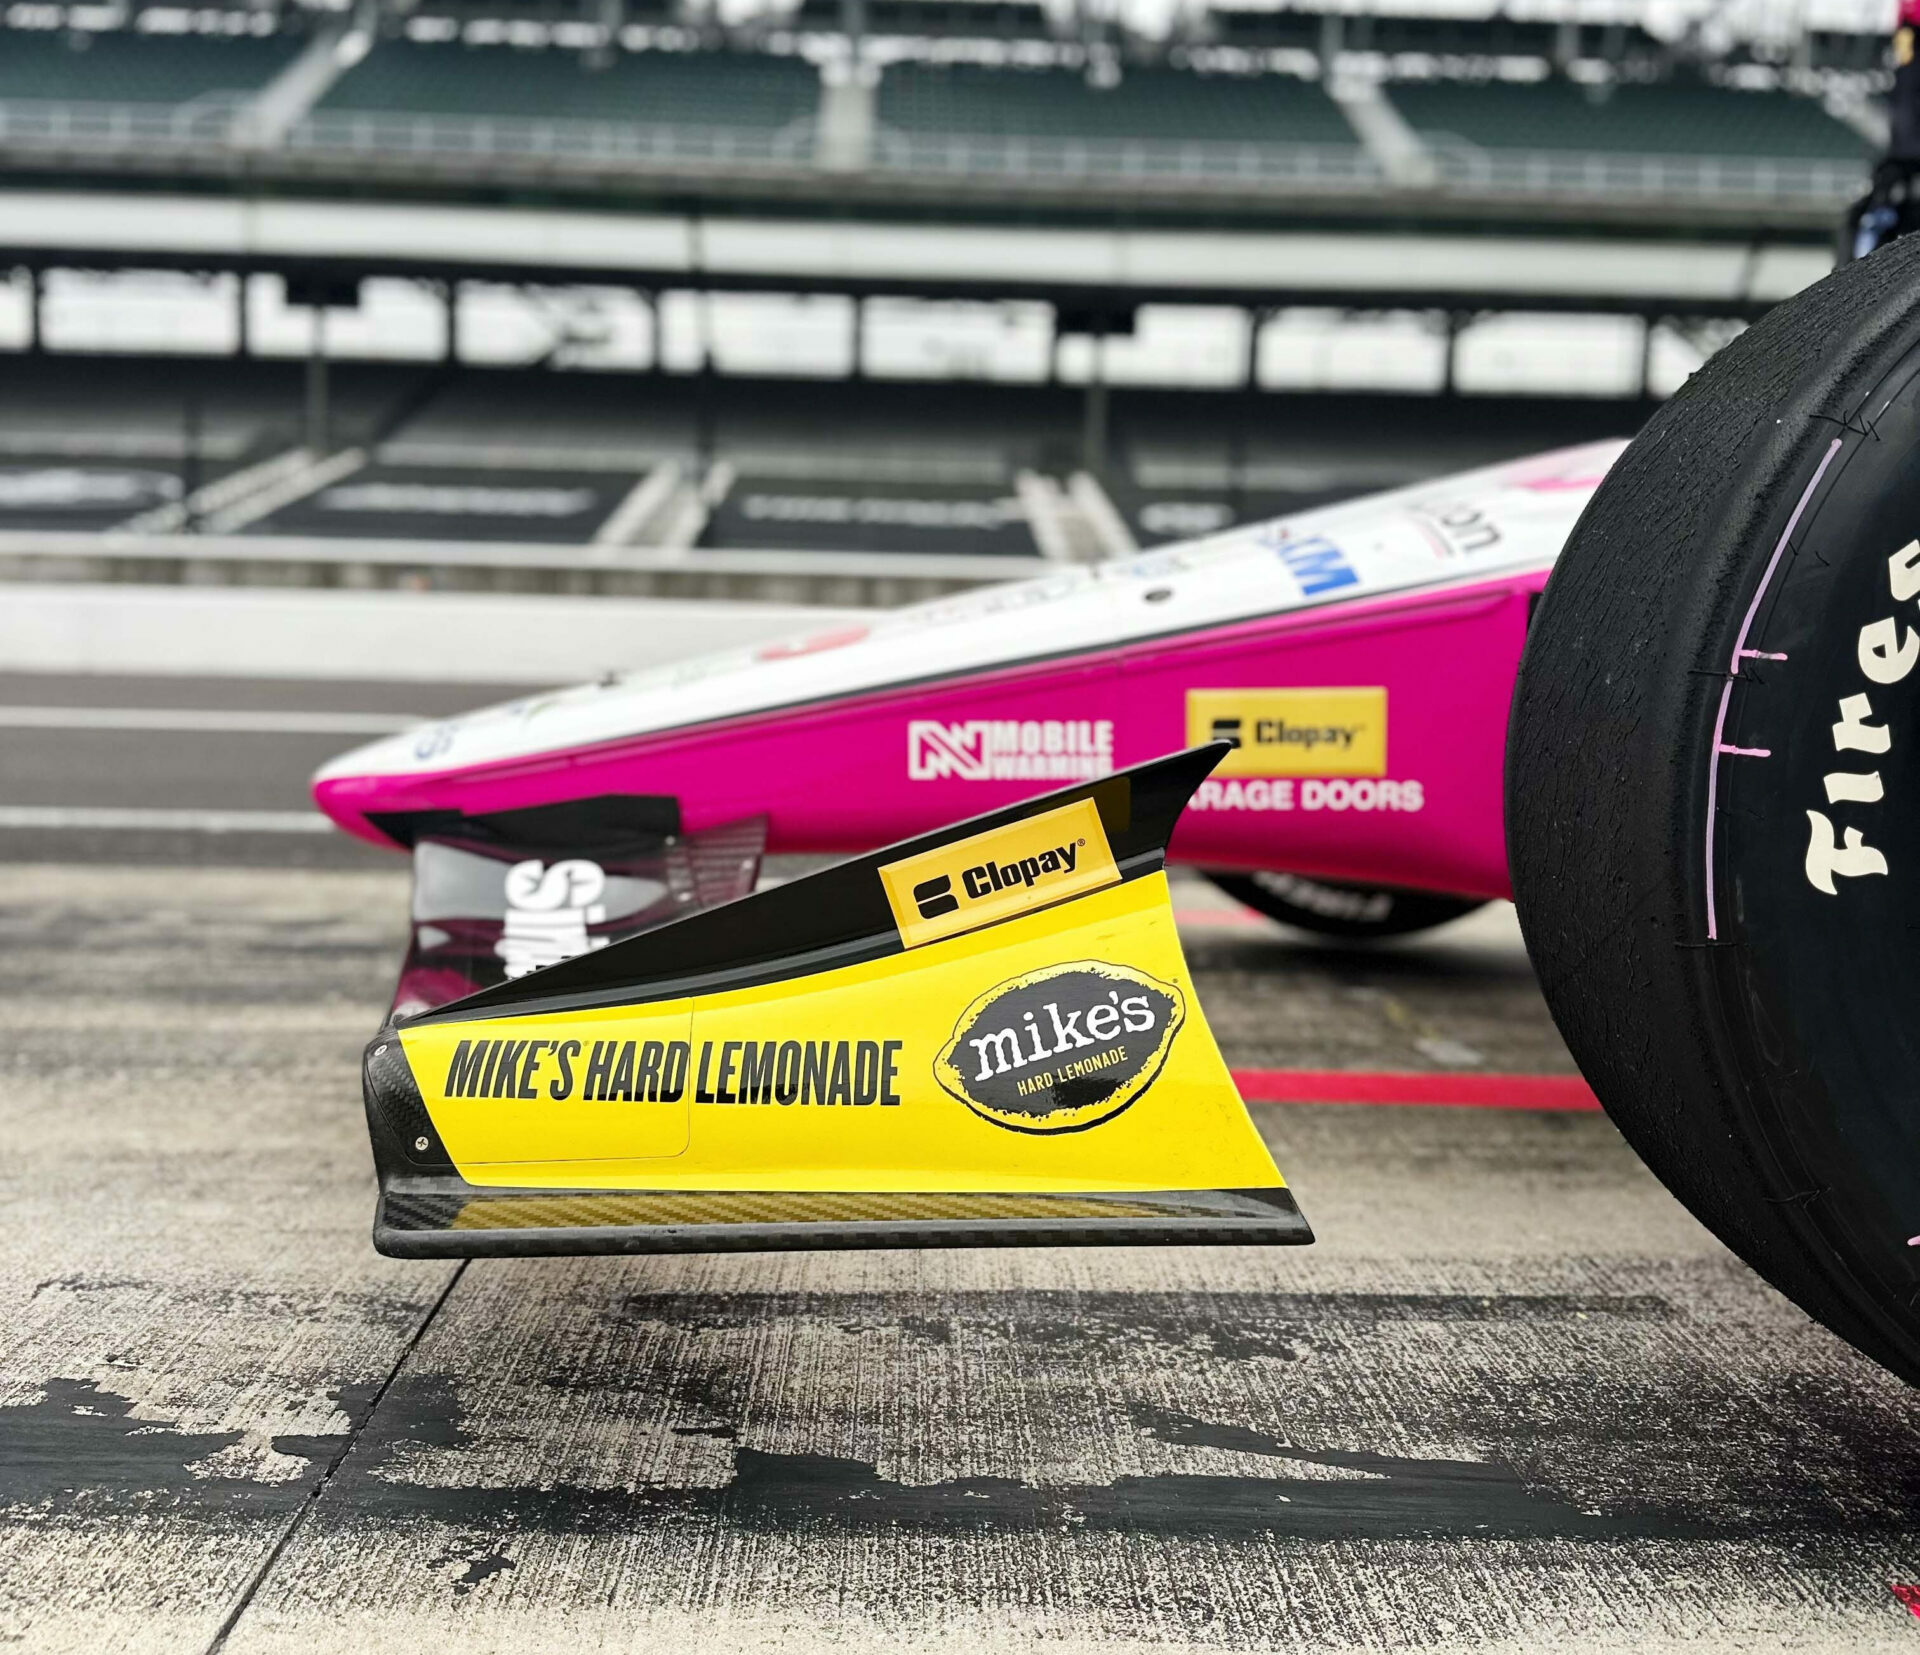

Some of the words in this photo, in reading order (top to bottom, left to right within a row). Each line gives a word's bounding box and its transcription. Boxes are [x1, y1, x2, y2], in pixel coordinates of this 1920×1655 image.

[991, 720, 1114, 754] MOBILE
[1301, 779, 1424, 812] DOORS
[969, 991, 1156, 1082] mike's
[444, 1040, 580, 1101] MIKE'S
[583, 1041, 690, 1102] HARD
[695, 1041, 902, 1107] LEMONADE
[1016, 1071, 1054, 1097] HARD
[1057, 1046, 1129, 1084] LEMONADE
